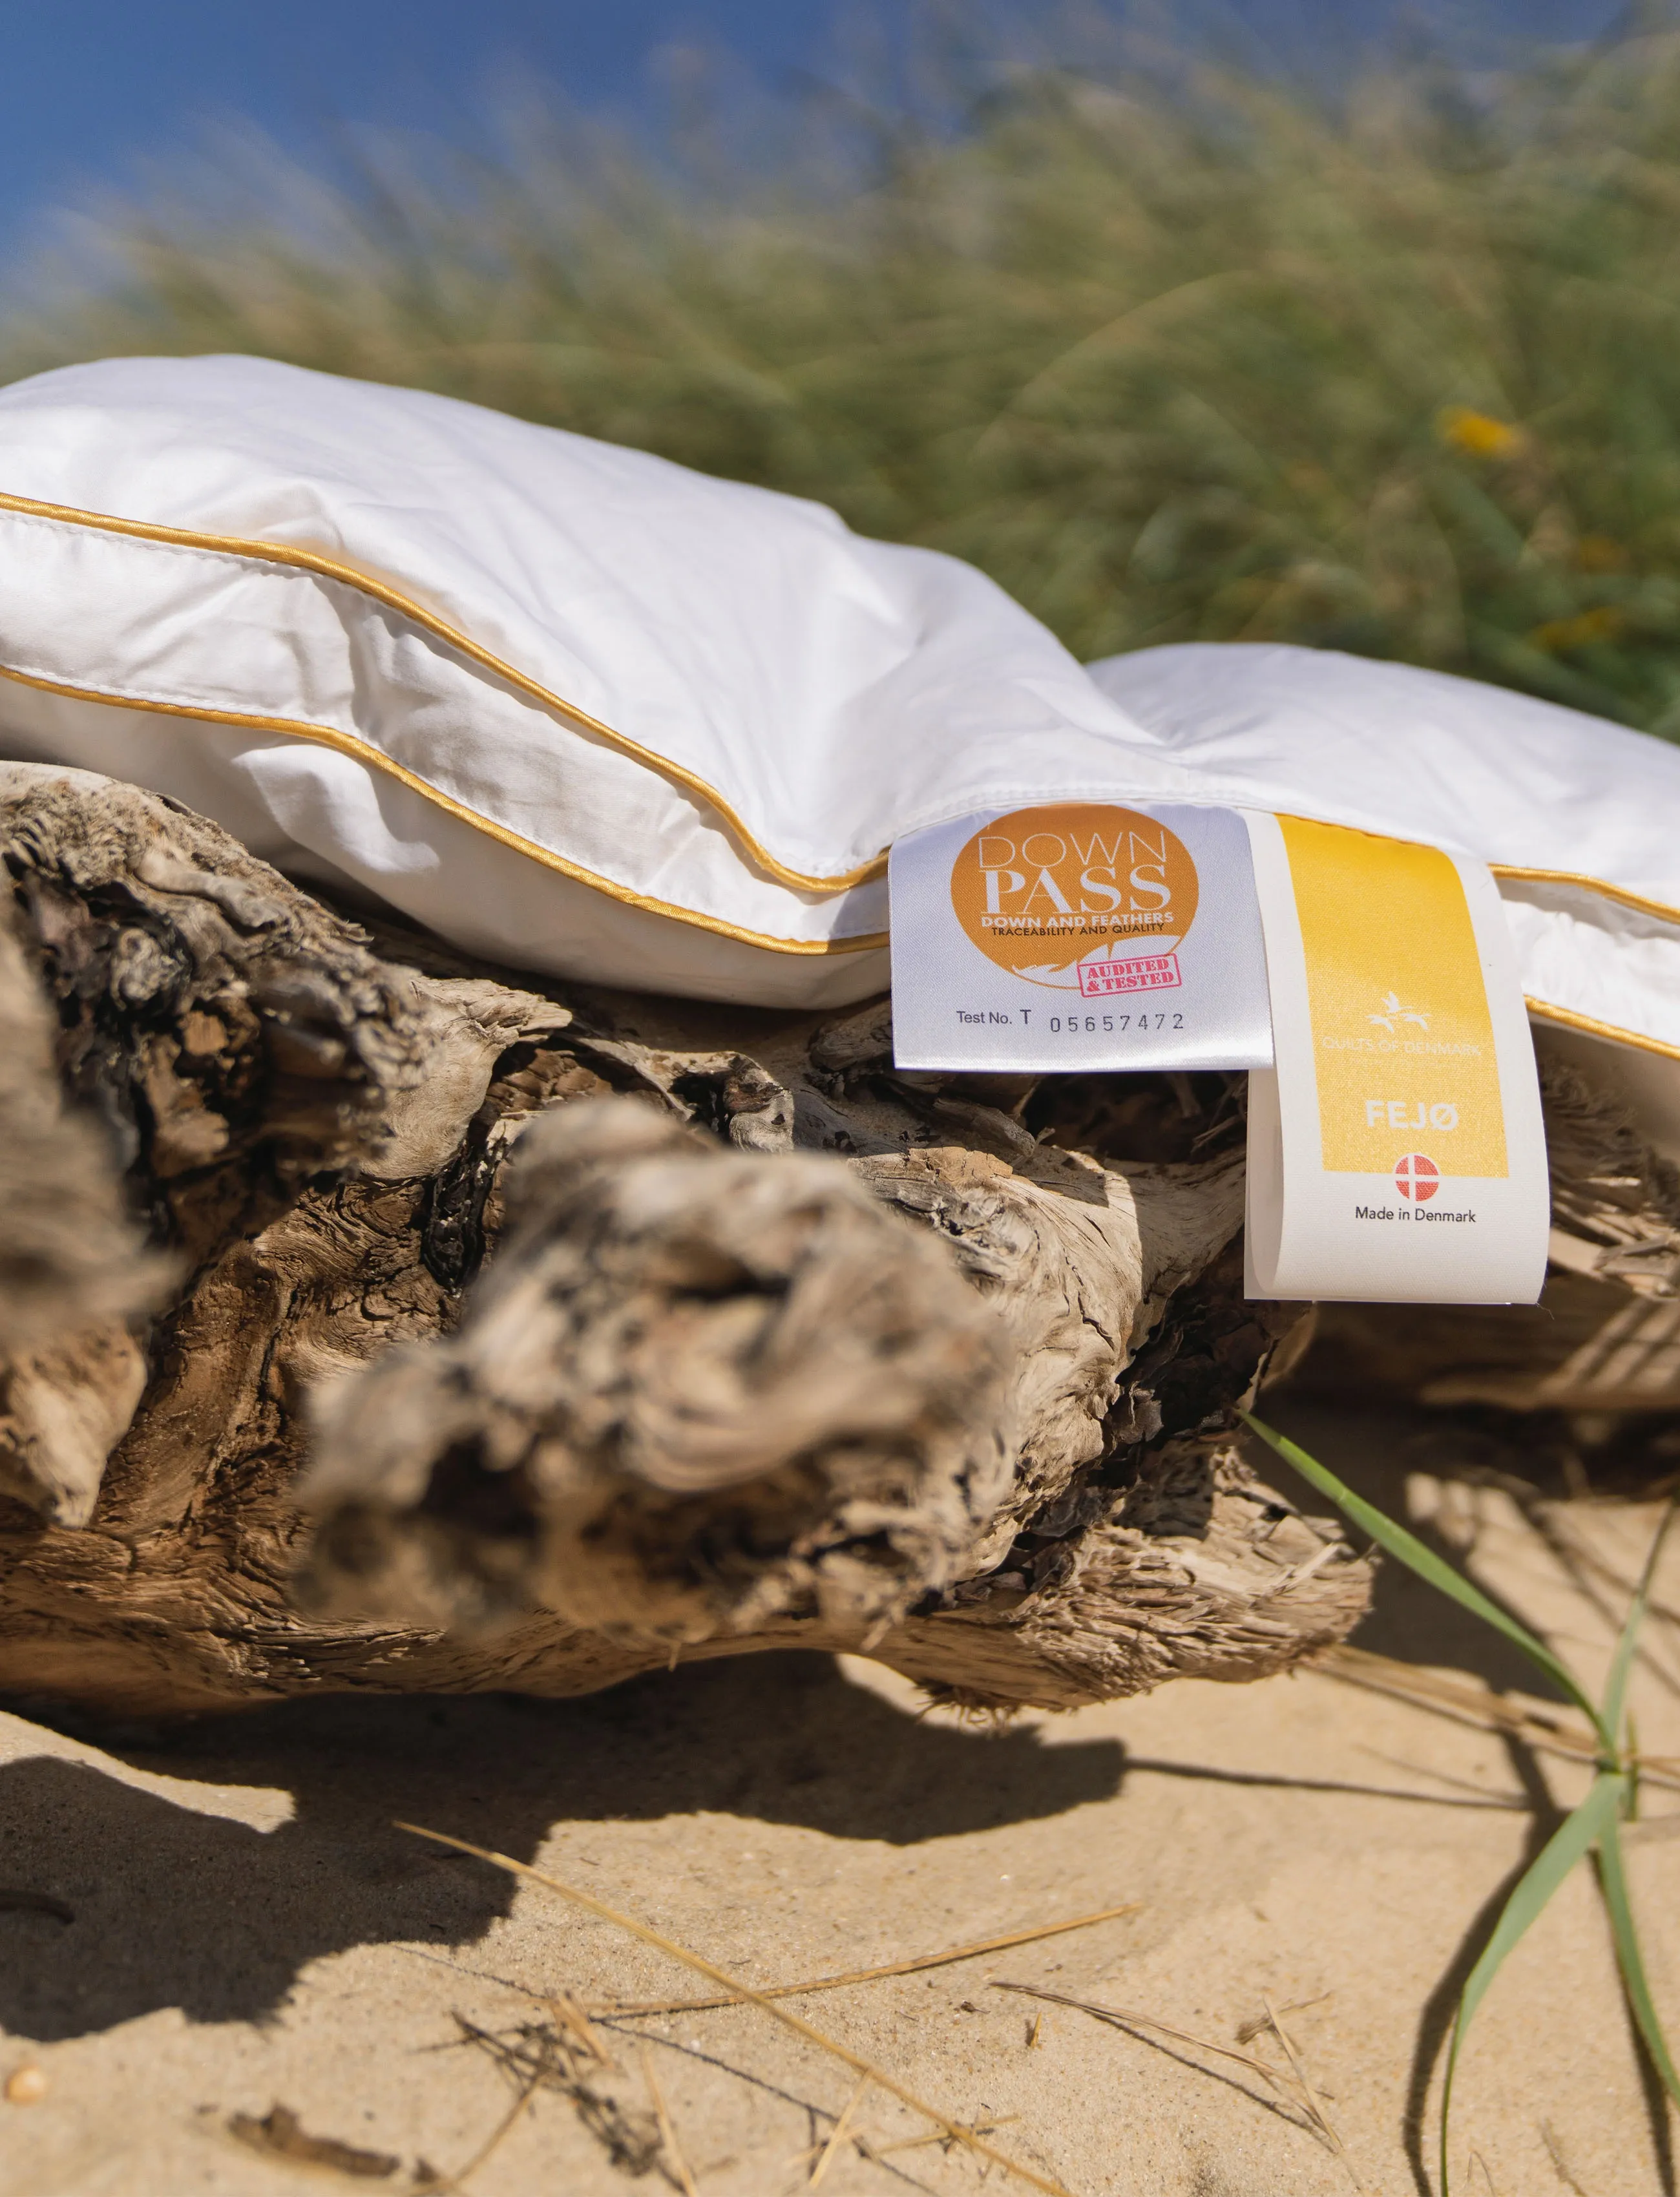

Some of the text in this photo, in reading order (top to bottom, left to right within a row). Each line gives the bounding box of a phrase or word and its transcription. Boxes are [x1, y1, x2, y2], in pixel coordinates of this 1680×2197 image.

[978, 831, 1166, 868] DOWN
[979, 864, 1171, 914] PASS
[981, 912, 1174, 928] DOWN AND FEATHERS
[991, 922, 1165, 936] TRACEABILITY AND QUALITY
[1086, 958, 1170, 979] AUDITED
[1086, 971, 1174, 992] & TESTED
[956, 1011, 985, 1024] Test
[989, 1012, 1013, 1025] No.
[1020, 1009, 1032, 1025] T
[1322, 1036, 1482, 1056] QUILTS OF DENMARK
[1365, 1099, 1459, 1131] FEJØ
[1355, 1206, 1476, 1223] Made in Denmark
